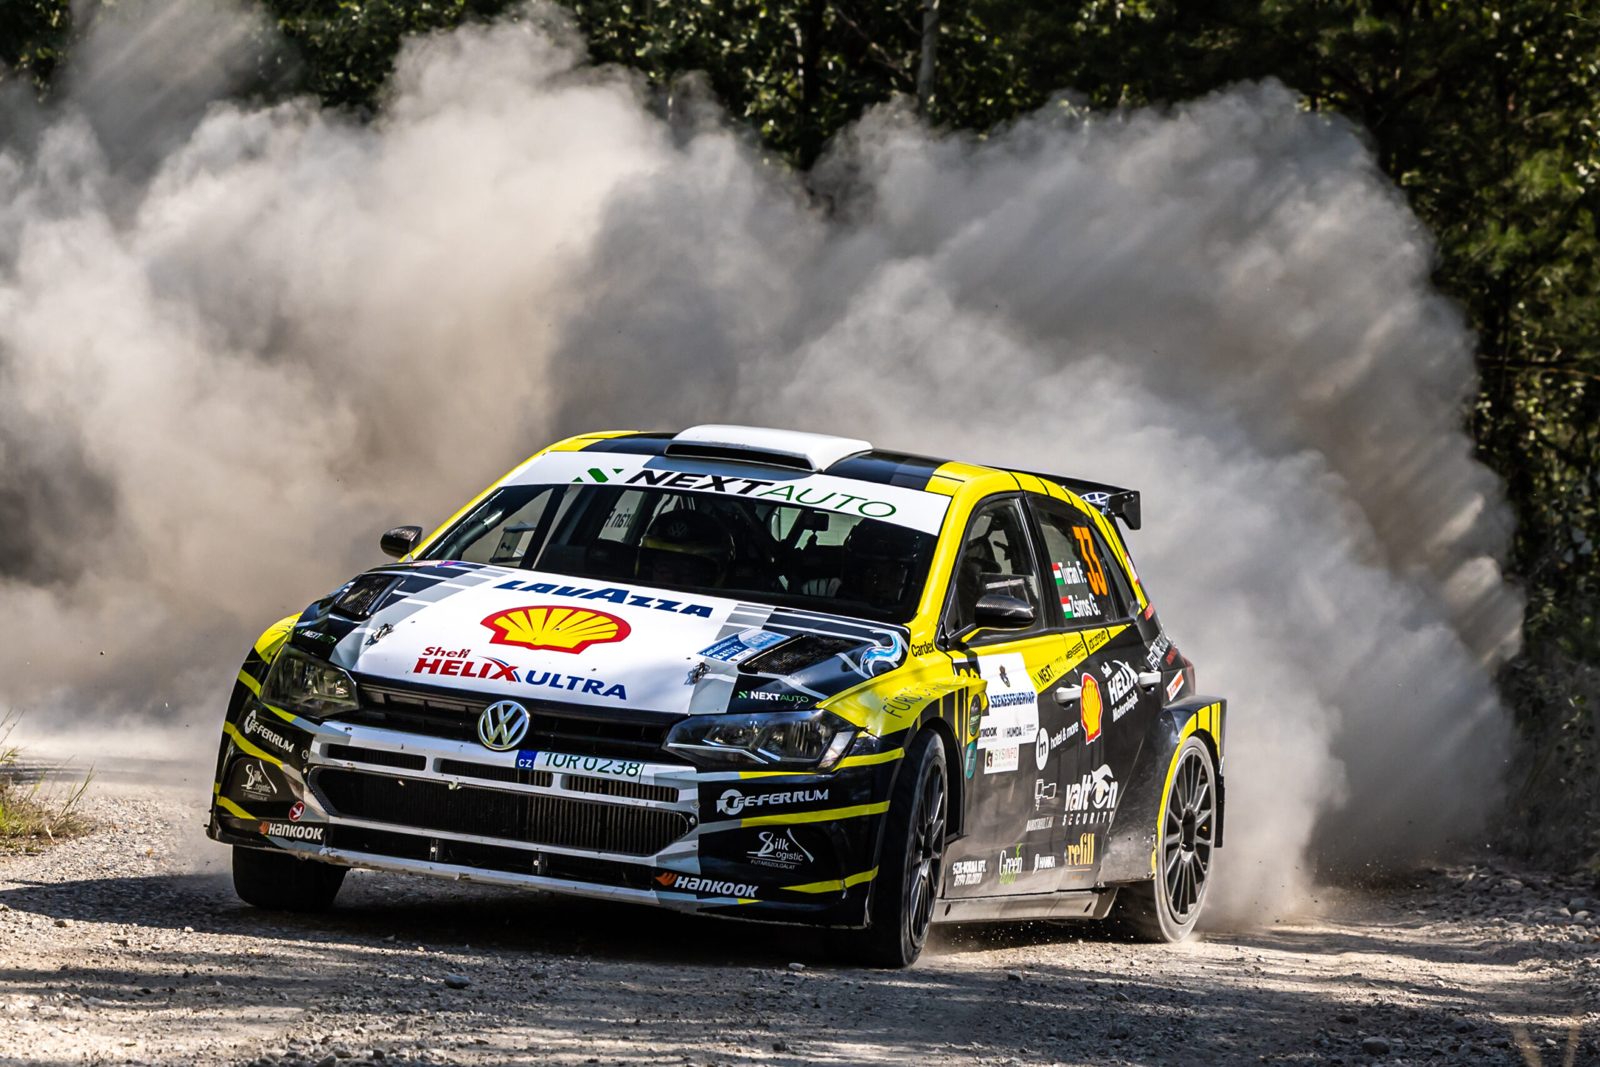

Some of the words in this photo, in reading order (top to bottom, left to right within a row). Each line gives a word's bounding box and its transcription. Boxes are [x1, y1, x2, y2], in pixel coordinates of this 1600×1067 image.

[624, 469, 897, 518] NEXTAUTO
[1072, 526, 1108, 596] 33
[493, 580, 714, 618] LAVAZZA
[422, 646, 472, 659] Shell
[413, 655, 521, 683] HELIX
[525, 670, 627, 700] ULTRA
[1107, 660, 1139, 705] HELIX
[750, 691, 809, 703] NEXTAUTO
[518, 758, 532, 768] CZ
[1062, 810, 1114, 826] SECURITY
[999, 849, 1023, 876] Green
[1067, 832, 1095, 866] refill
